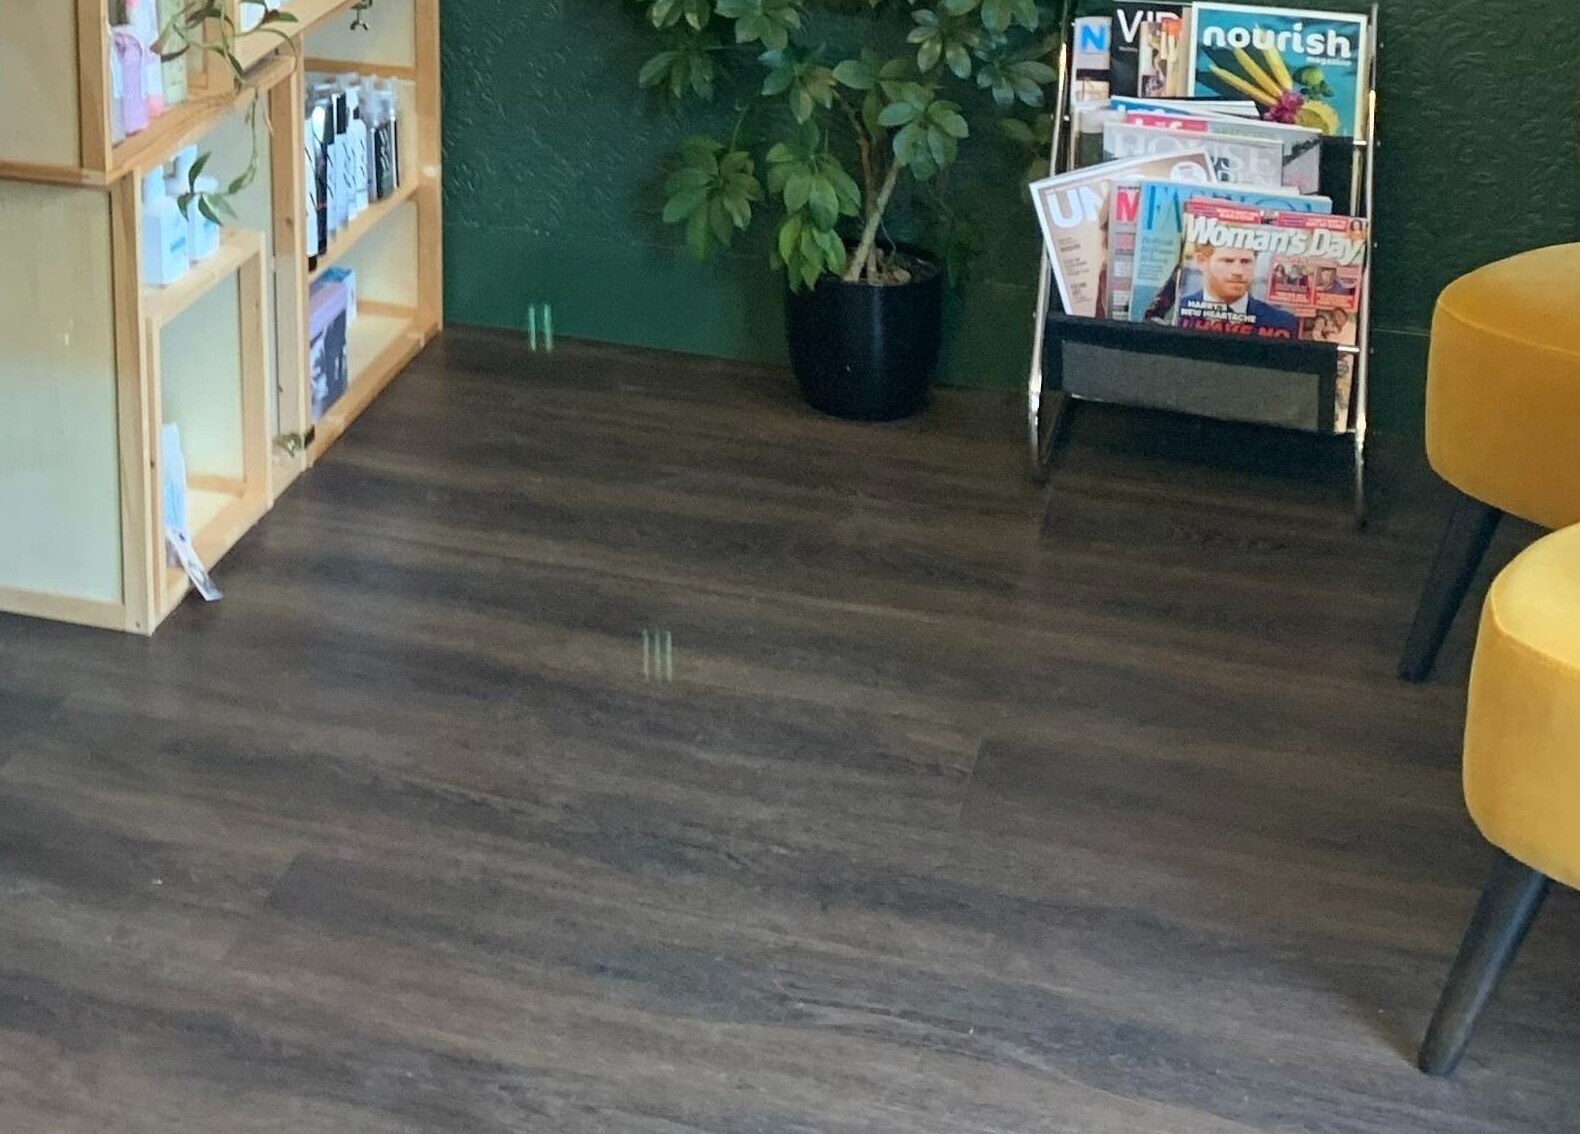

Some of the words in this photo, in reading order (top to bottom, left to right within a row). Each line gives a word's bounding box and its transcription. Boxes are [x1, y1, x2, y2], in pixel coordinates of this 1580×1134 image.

[1202, 23, 1352, 58] nourish
[1186, 214, 1307, 258] Woman's
[1309, 228, 1368, 266] Day
